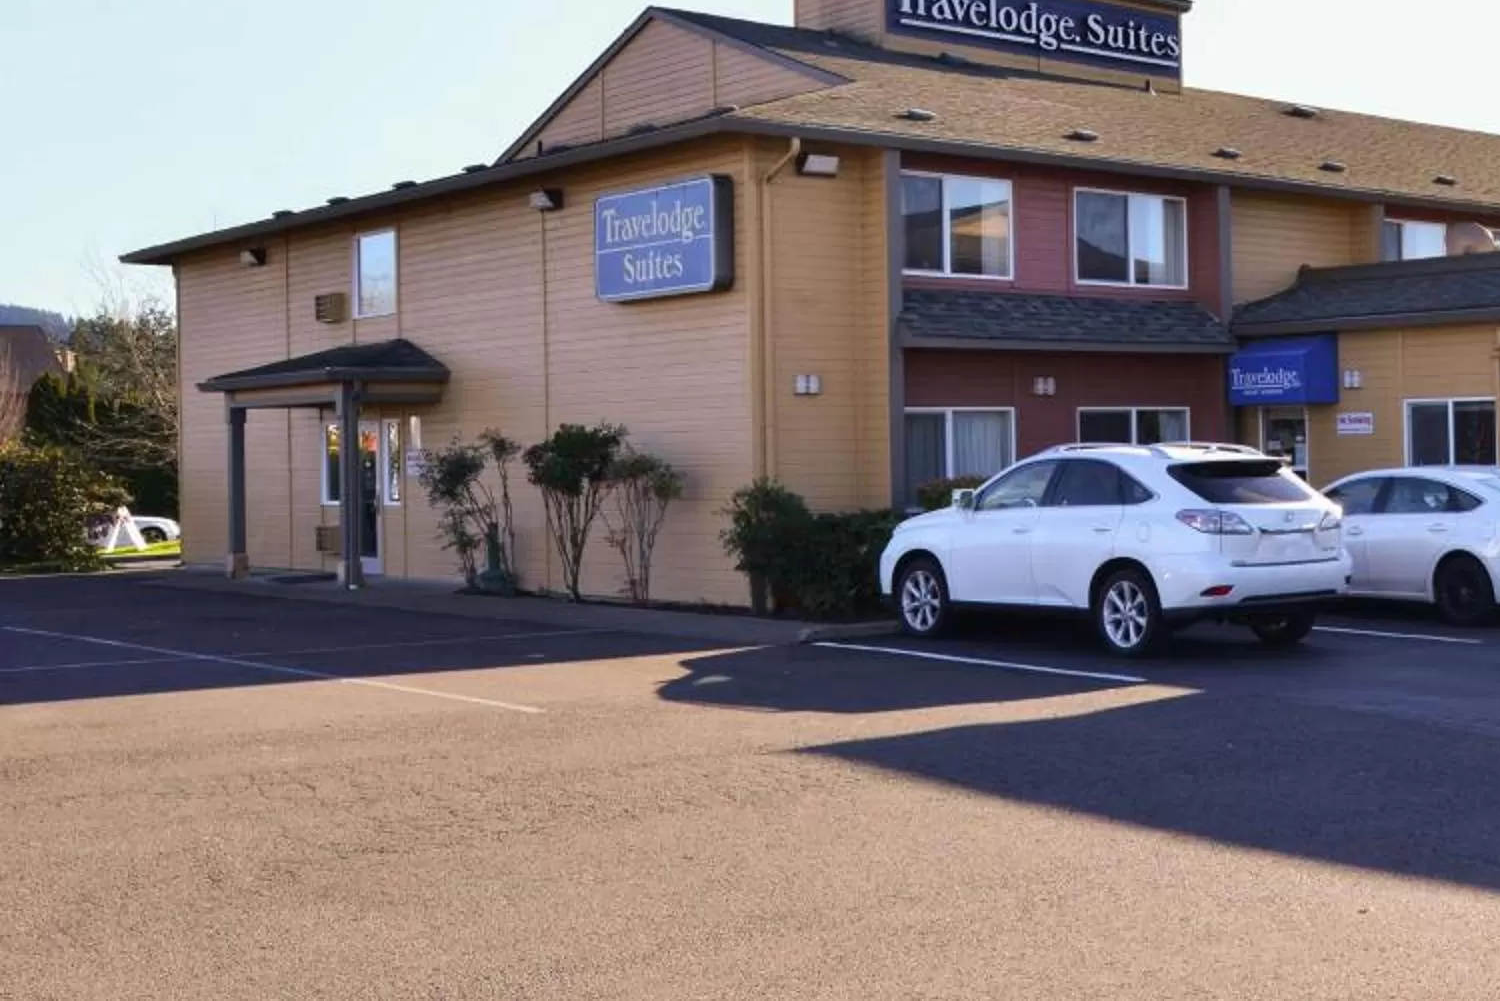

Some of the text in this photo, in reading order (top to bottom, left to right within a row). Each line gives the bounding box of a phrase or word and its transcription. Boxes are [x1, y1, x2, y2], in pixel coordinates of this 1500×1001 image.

[1087, 13, 1180, 57] Suites
[602, 200, 705, 244] Travelodge
[623, 250, 684, 284] Suites
